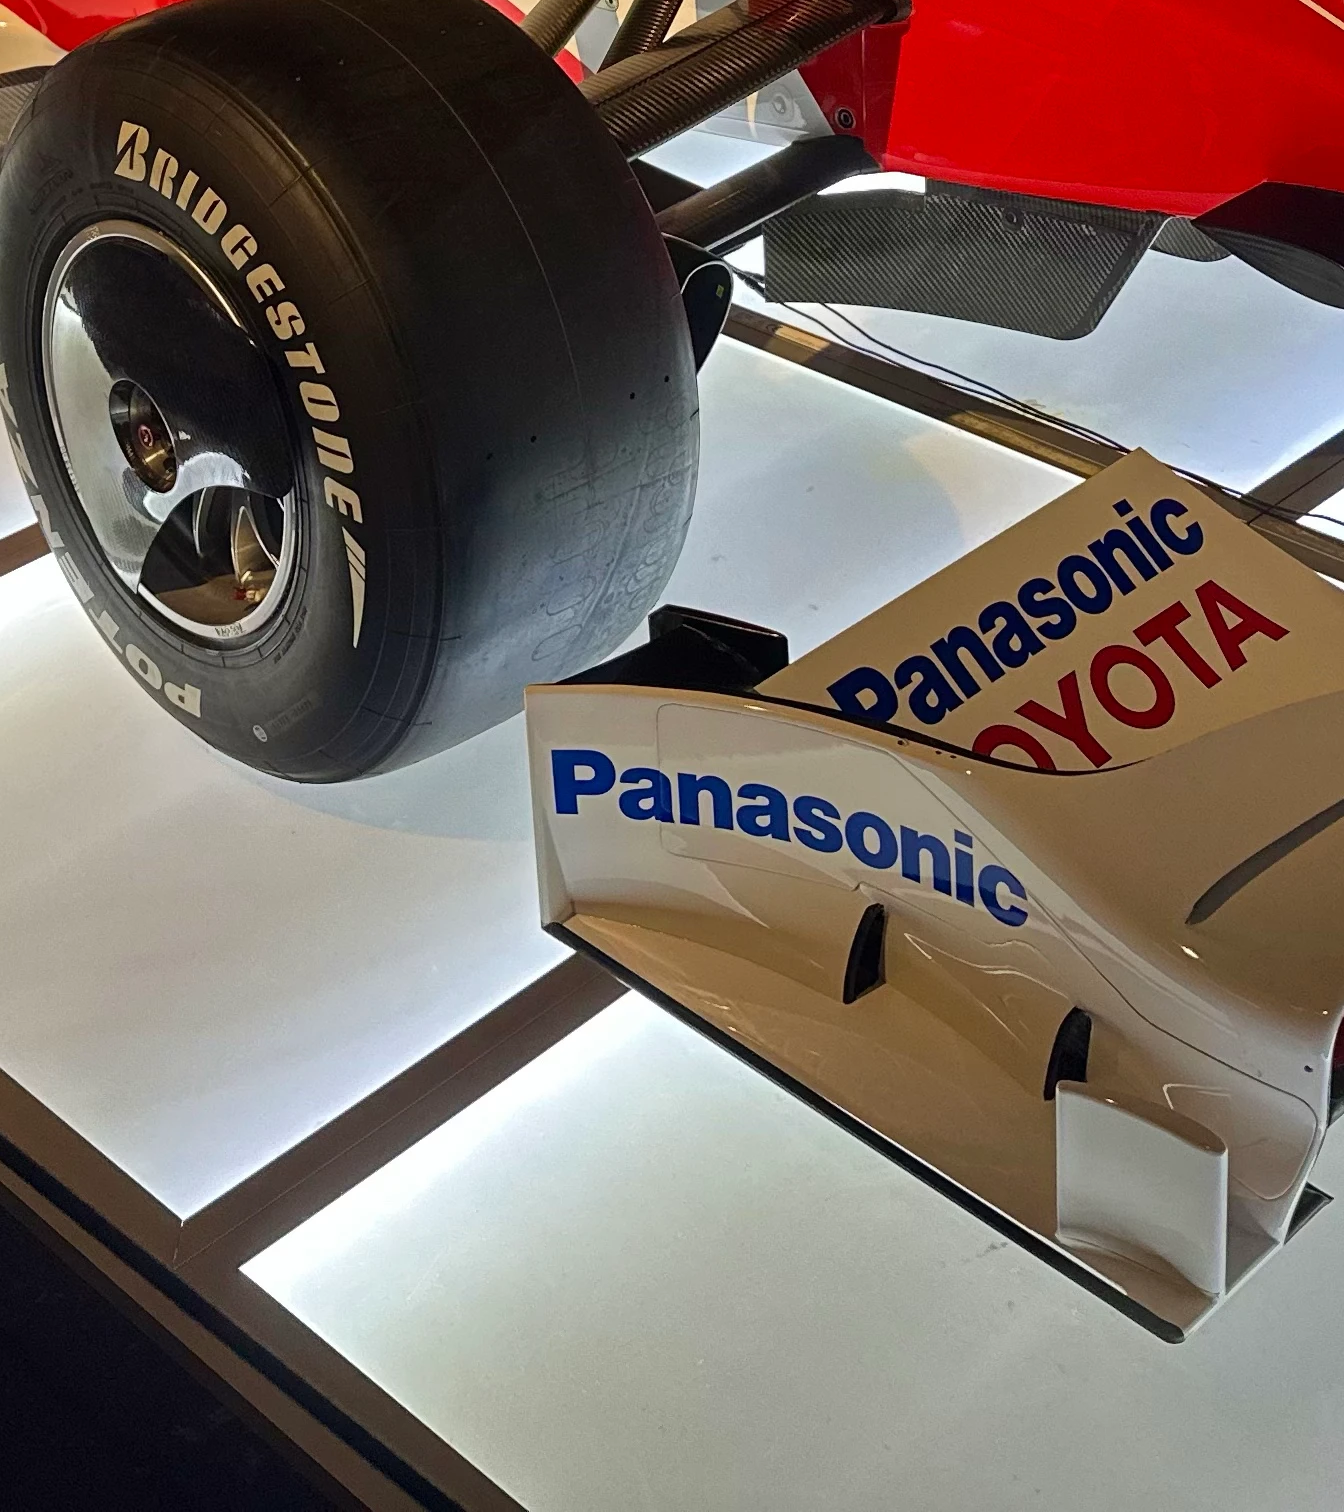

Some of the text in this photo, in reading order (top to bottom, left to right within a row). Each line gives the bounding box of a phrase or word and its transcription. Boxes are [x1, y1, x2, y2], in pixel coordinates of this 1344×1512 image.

[114, 120, 363, 524] BRIDGESTONE
[826, 498, 1204, 724] Panasonic
[971, 579, 1290, 772] OYOTA
[551, 749, 1029, 927] Panasonic
